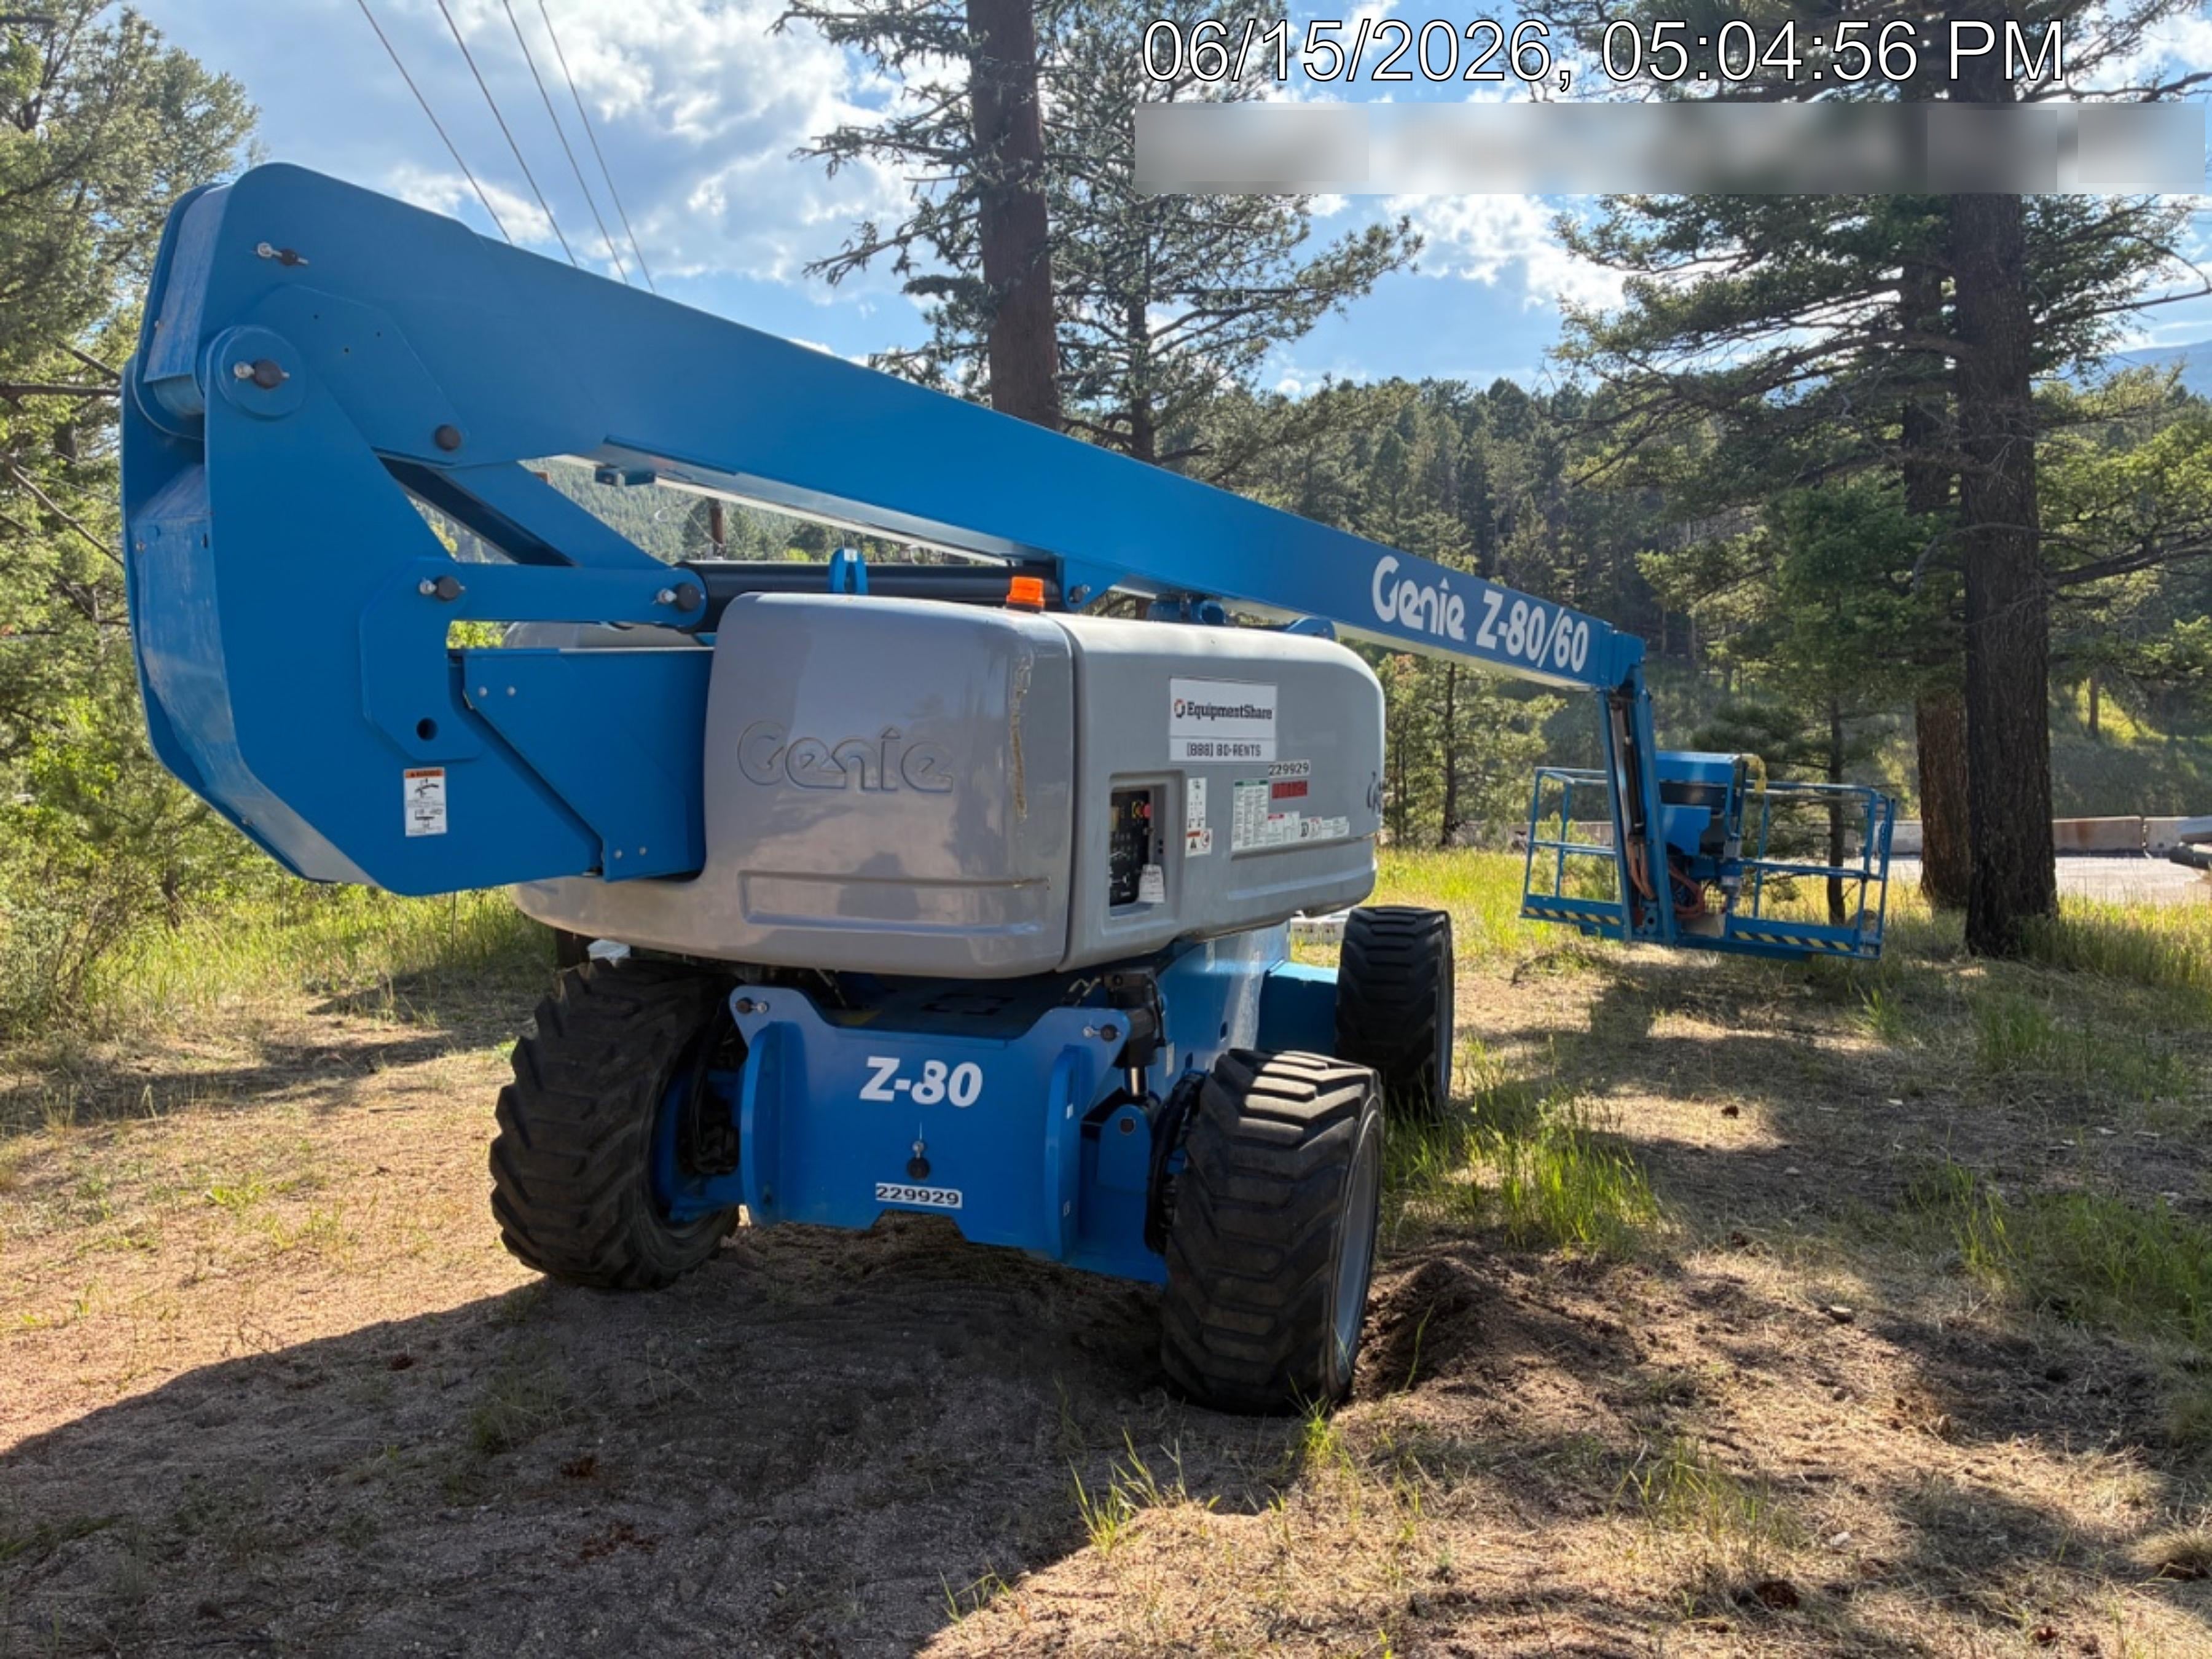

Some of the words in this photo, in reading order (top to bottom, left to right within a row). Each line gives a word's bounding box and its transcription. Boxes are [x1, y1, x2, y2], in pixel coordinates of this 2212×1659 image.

[1372, 555, 1467, 641] Genie
[1476, 589, 1589, 672] Z-80/60
[1186, 701, 1273, 721] EquipmentShare
[737, 720, 953, 793] Genie
[1268, 762, 1309, 775] 229929
[860, 1056, 983, 1107] Z-80
[877, 1185, 959, 1205] 229929
